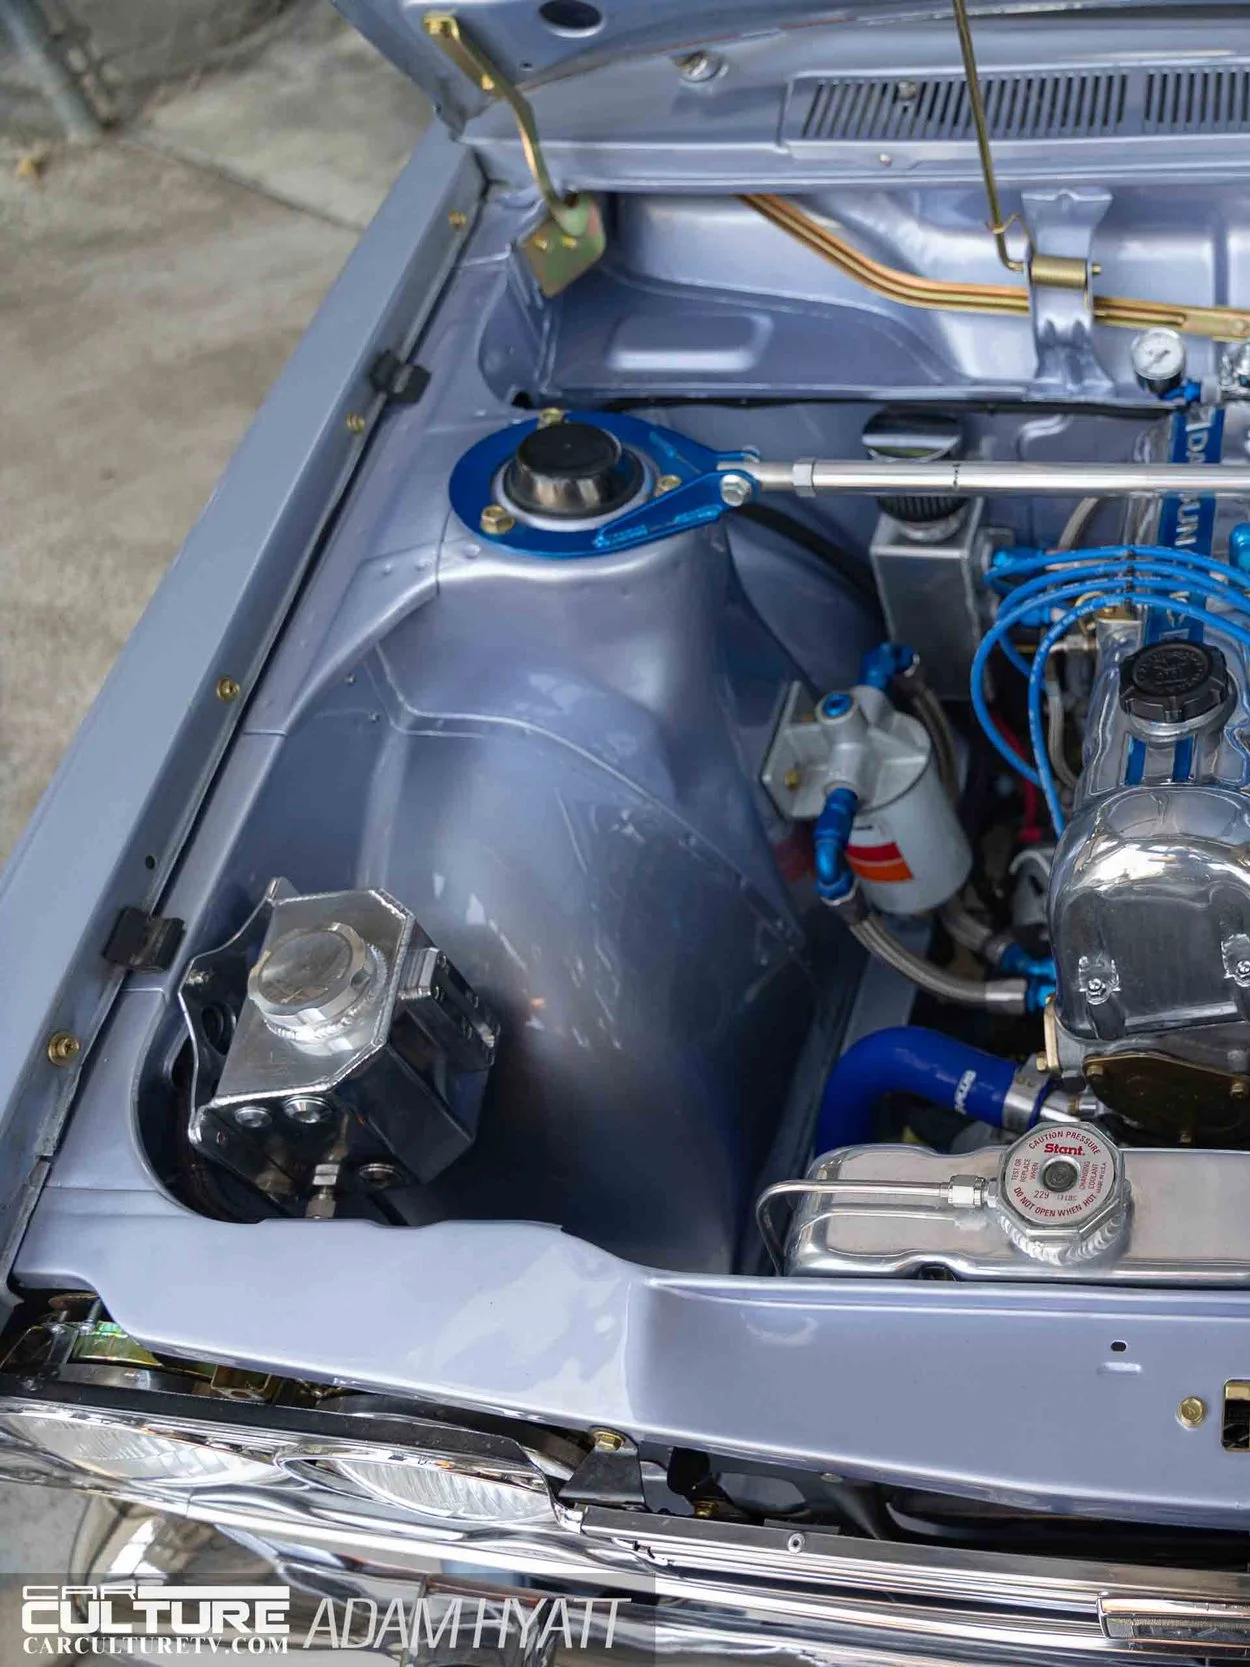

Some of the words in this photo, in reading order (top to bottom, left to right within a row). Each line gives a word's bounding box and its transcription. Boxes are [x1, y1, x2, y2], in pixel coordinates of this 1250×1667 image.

[1174, 430, 1208, 546] DAUN
[1028, 1131, 1063, 1150] CAUTION
[1066, 1131, 1100, 1155] PRESSURE
[1020, 1159, 1031, 1182] REPLACE
[1088, 1163, 1098, 1189] COOLANT
[1014, 1187, 1023, 1197] DO
[1020, 1196, 1035, 1210] NOT
[1034, 1206, 1056, 1217] OPEN
[1057, 1204, 1082, 1217] WHEN
[1083, 1193, 1097, 1208] HOT
[1034, 1190, 1049, 1199] 229
